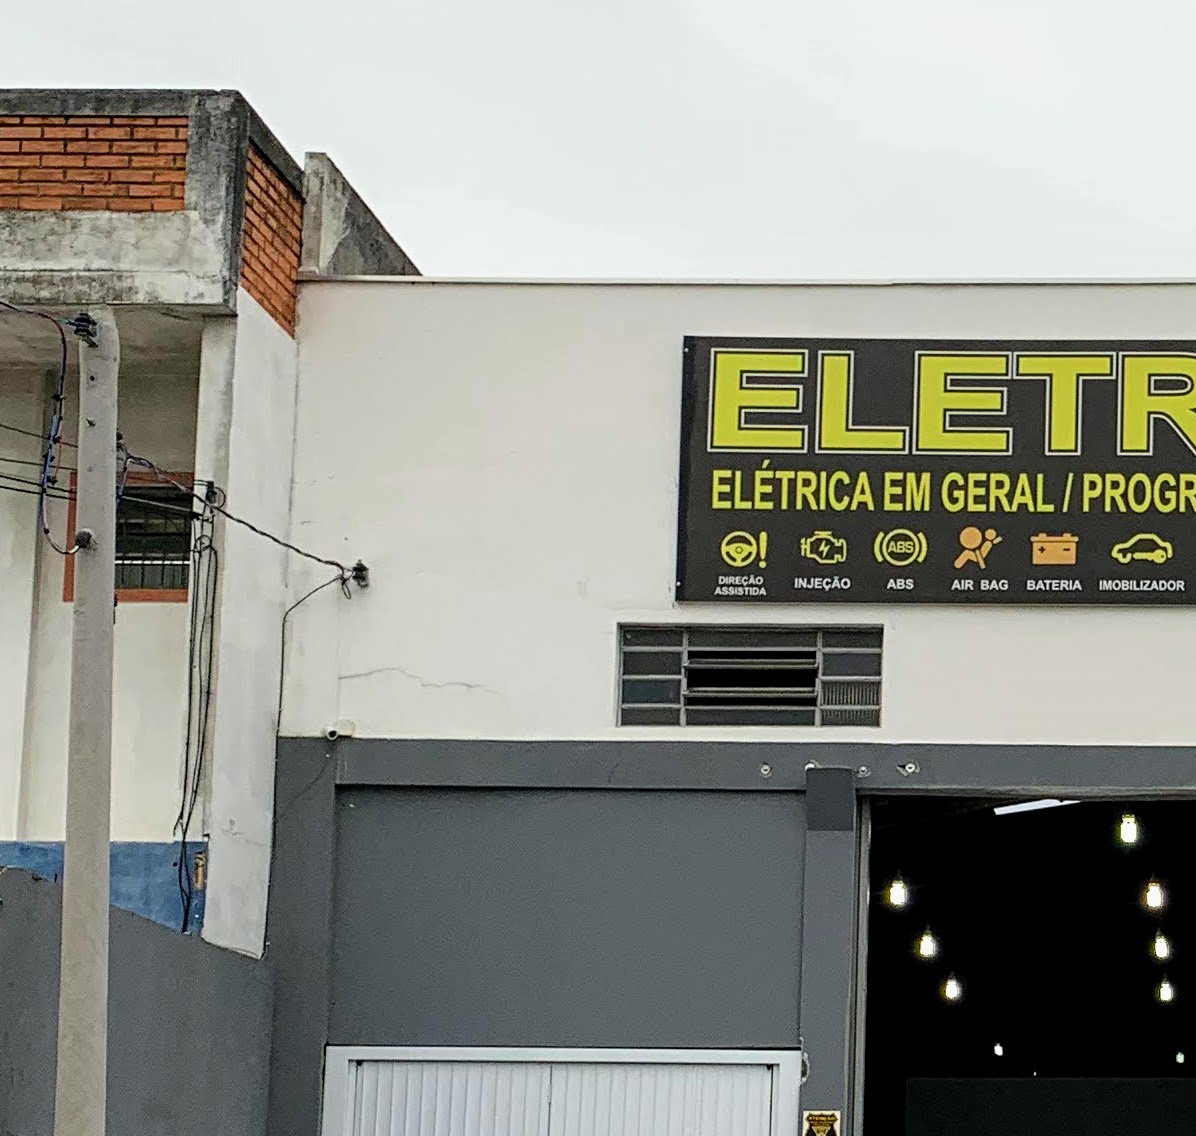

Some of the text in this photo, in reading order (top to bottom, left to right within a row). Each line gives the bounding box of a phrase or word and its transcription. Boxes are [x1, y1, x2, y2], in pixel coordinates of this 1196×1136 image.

[711, 460, 875, 512] ELÉTRICA
[883, 472, 930, 512] EM
[941, 472, 1055, 513] GERAL
[1062, 473, 1074, 513] /
[888, 541, 914, 553] ABS
[718, 575, 764, 586] DIREÇÃO
[794, 576, 851, 592] INJEÇÃO
[887, 578, 915, 590] ABS
[951, 579, 1009, 591] AIR BAG
[1026, 579, 1083, 591] BATERIA
[1099, 579, 1185, 592] IMOBILIZADOR
[714, 587, 767, 596] ASSISTIDA
